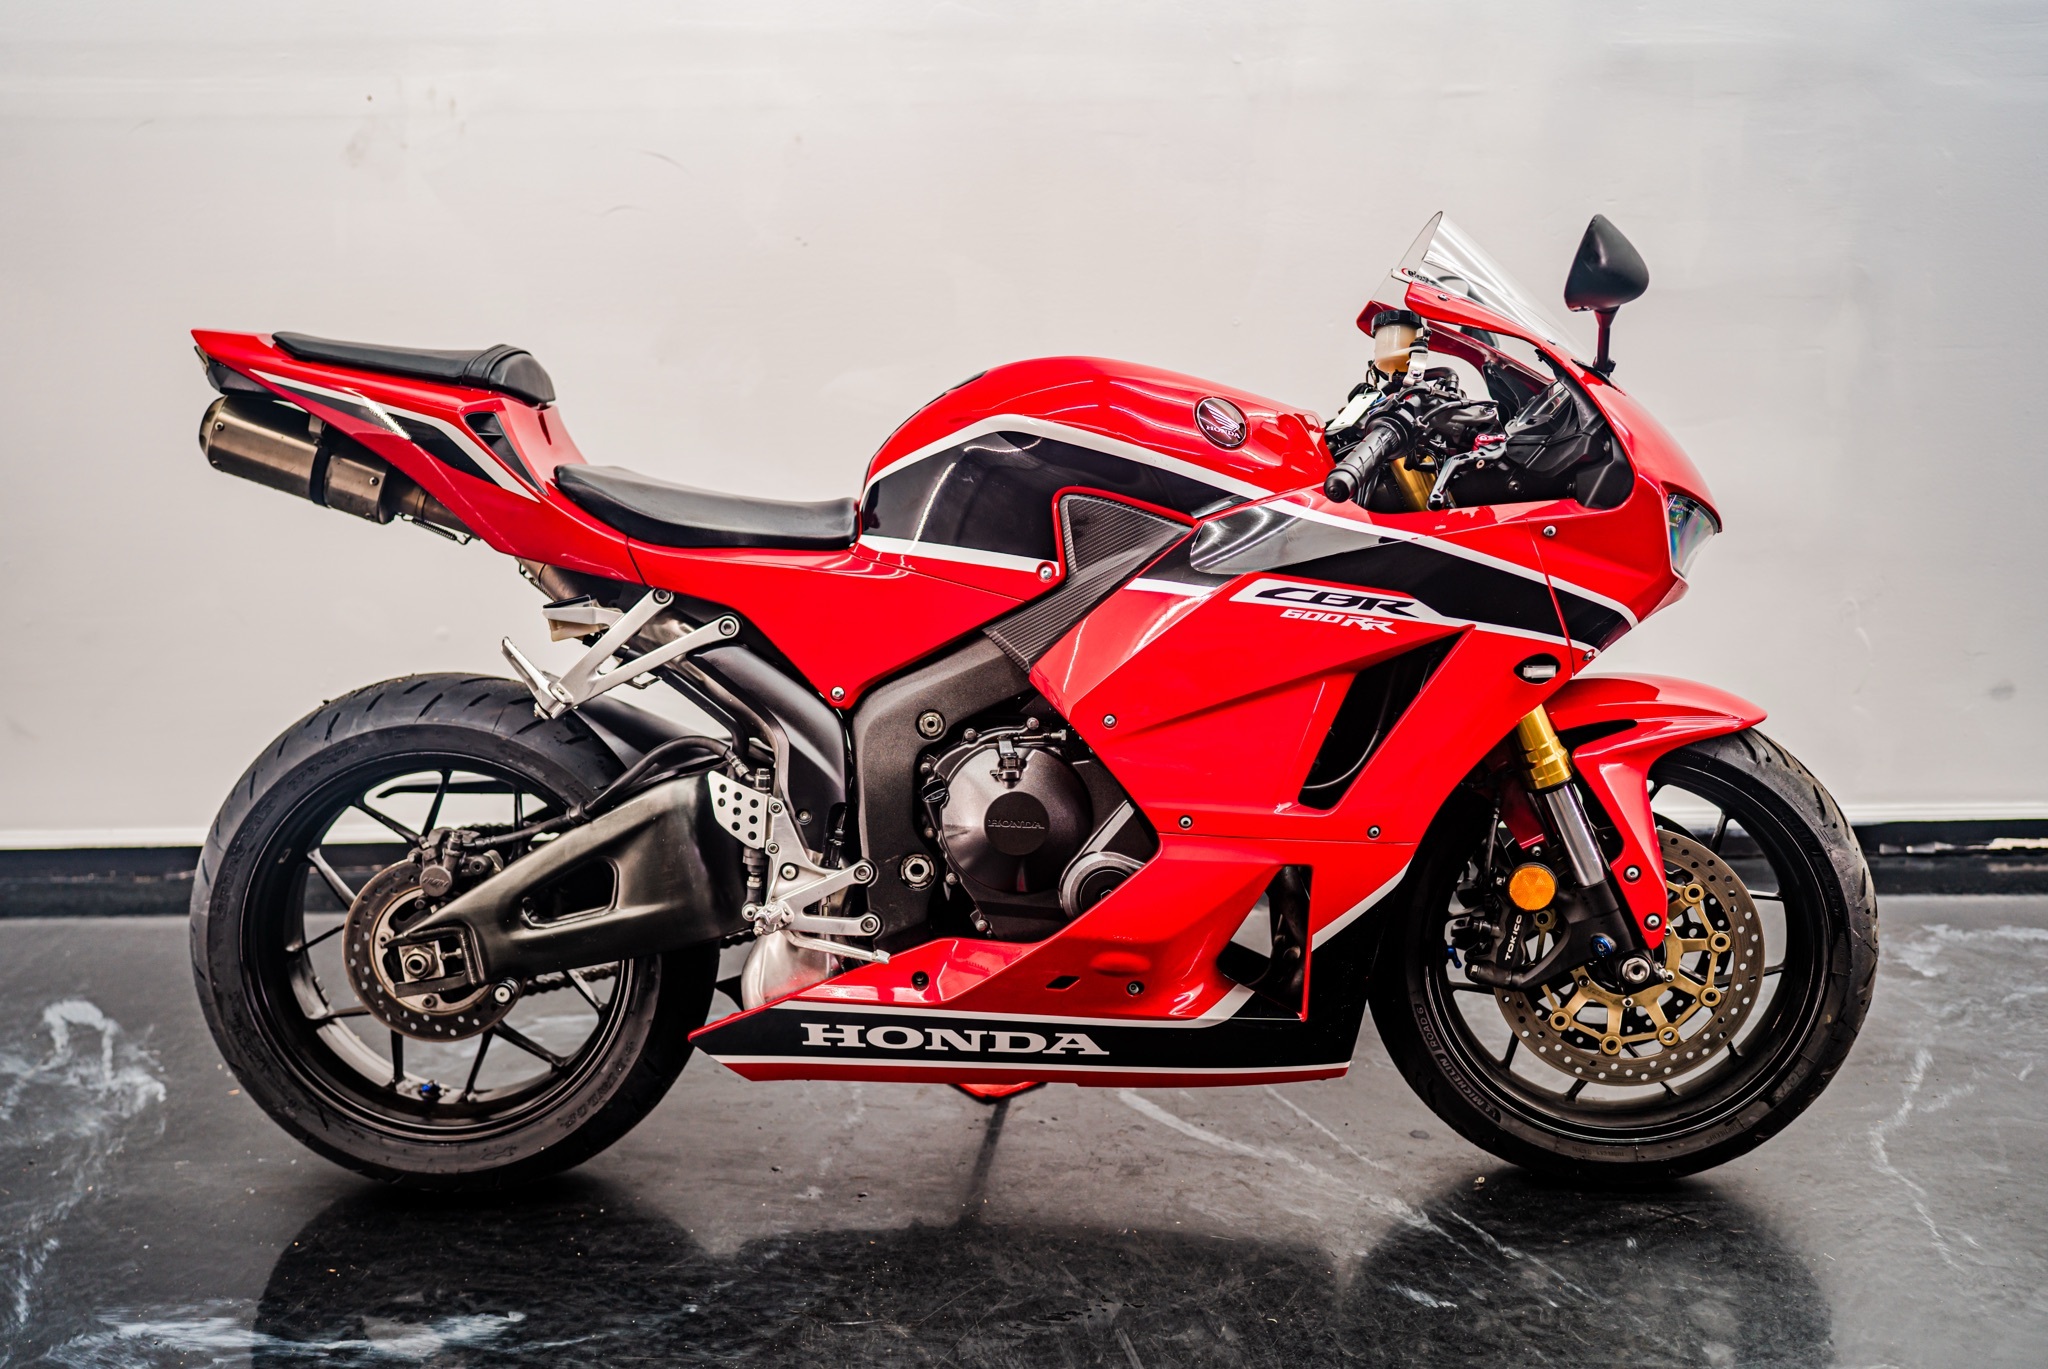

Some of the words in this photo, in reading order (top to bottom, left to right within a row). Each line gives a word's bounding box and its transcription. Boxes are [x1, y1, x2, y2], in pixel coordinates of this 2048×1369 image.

[1255, 587, 1419, 618] CBR
[1280, 609, 1397, 634] 600RR
[988, 819, 1045, 830] HONDA
[1504, 914, 1523, 961] TOKICO
[1416, 1006, 1424, 1014] 6
[801, 1023, 1109, 1055] HONDA
[1421, 1018, 1438, 1048] ROAD
[1440, 1058, 1485, 1107] MICHELIN
